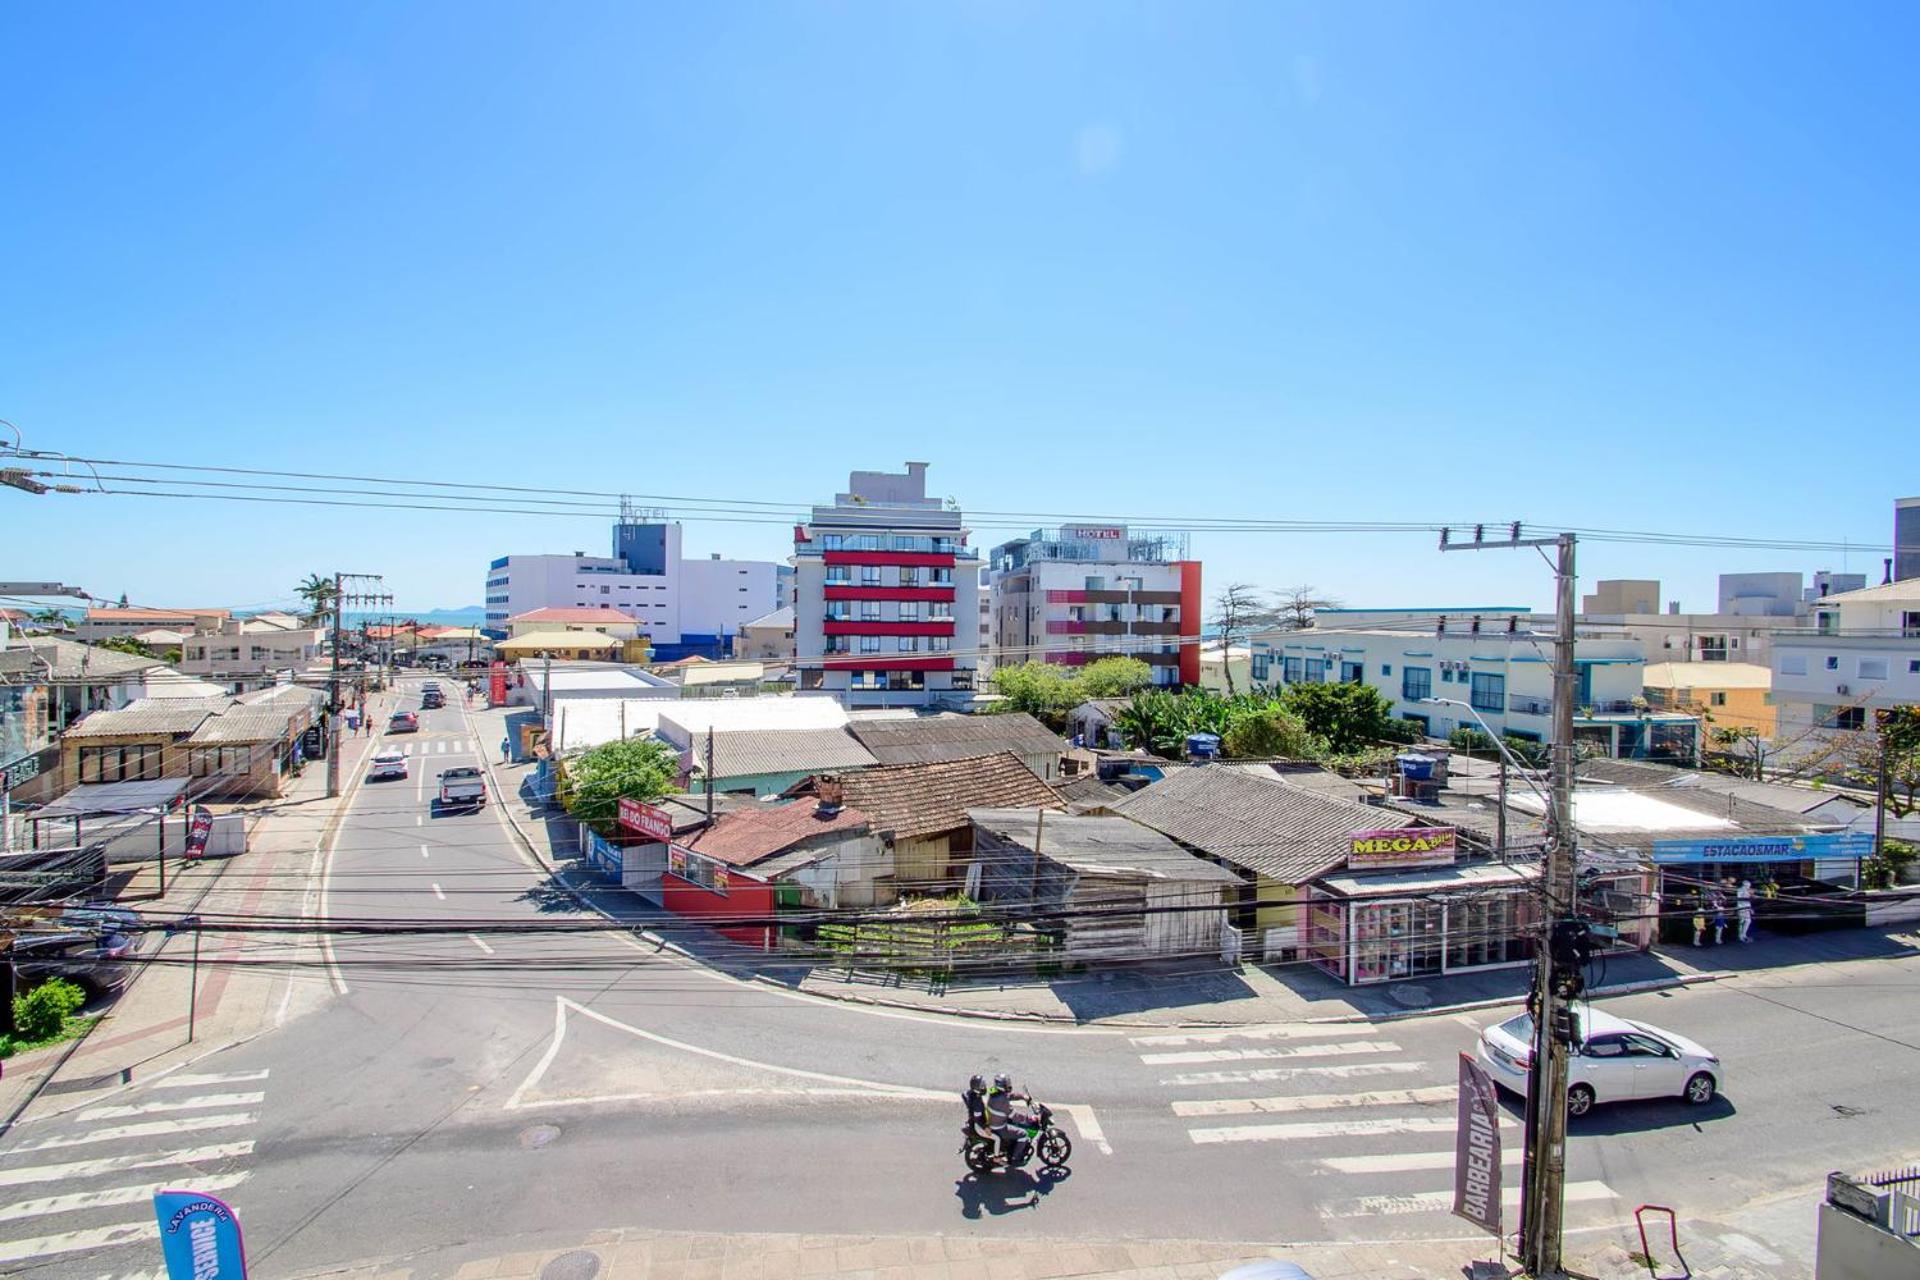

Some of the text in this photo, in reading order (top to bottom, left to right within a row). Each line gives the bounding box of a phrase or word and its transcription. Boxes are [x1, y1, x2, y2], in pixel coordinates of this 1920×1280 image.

[1076, 529, 1120, 539] HOTEL
[641, 814, 671, 837] FRANGO
[1353, 838, 1430, 854] MEGA
[1463, 1112, 1494, 1221] BARBEARIA
[167, 1202, 229, 1234] LAVANDERIA
[190, 1217, 219, 1280] SERVICE
